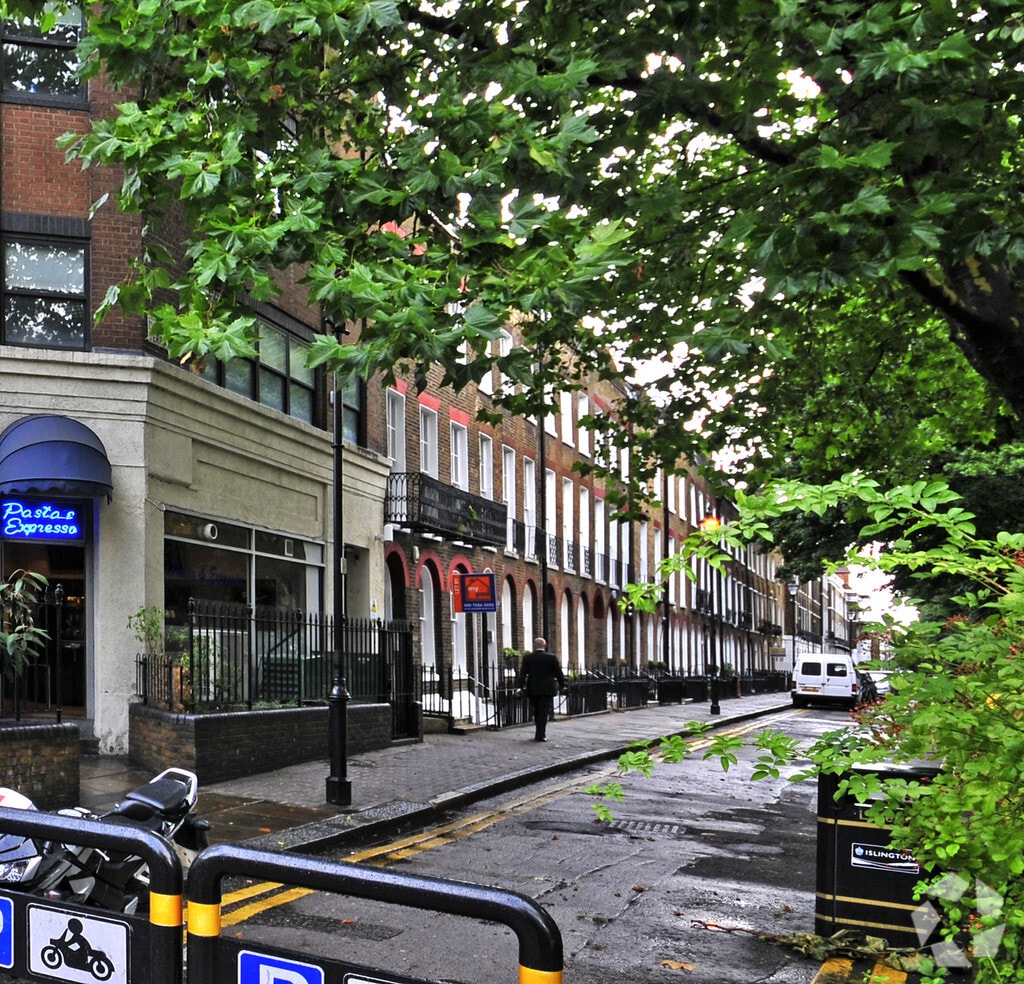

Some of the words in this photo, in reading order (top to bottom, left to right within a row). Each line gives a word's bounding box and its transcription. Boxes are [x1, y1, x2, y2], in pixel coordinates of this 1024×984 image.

[2, 502, 64, 520] Pasta
[4, 518, 78, 536] Expresso
[865, 849, 916, 862] ISLINGTON
